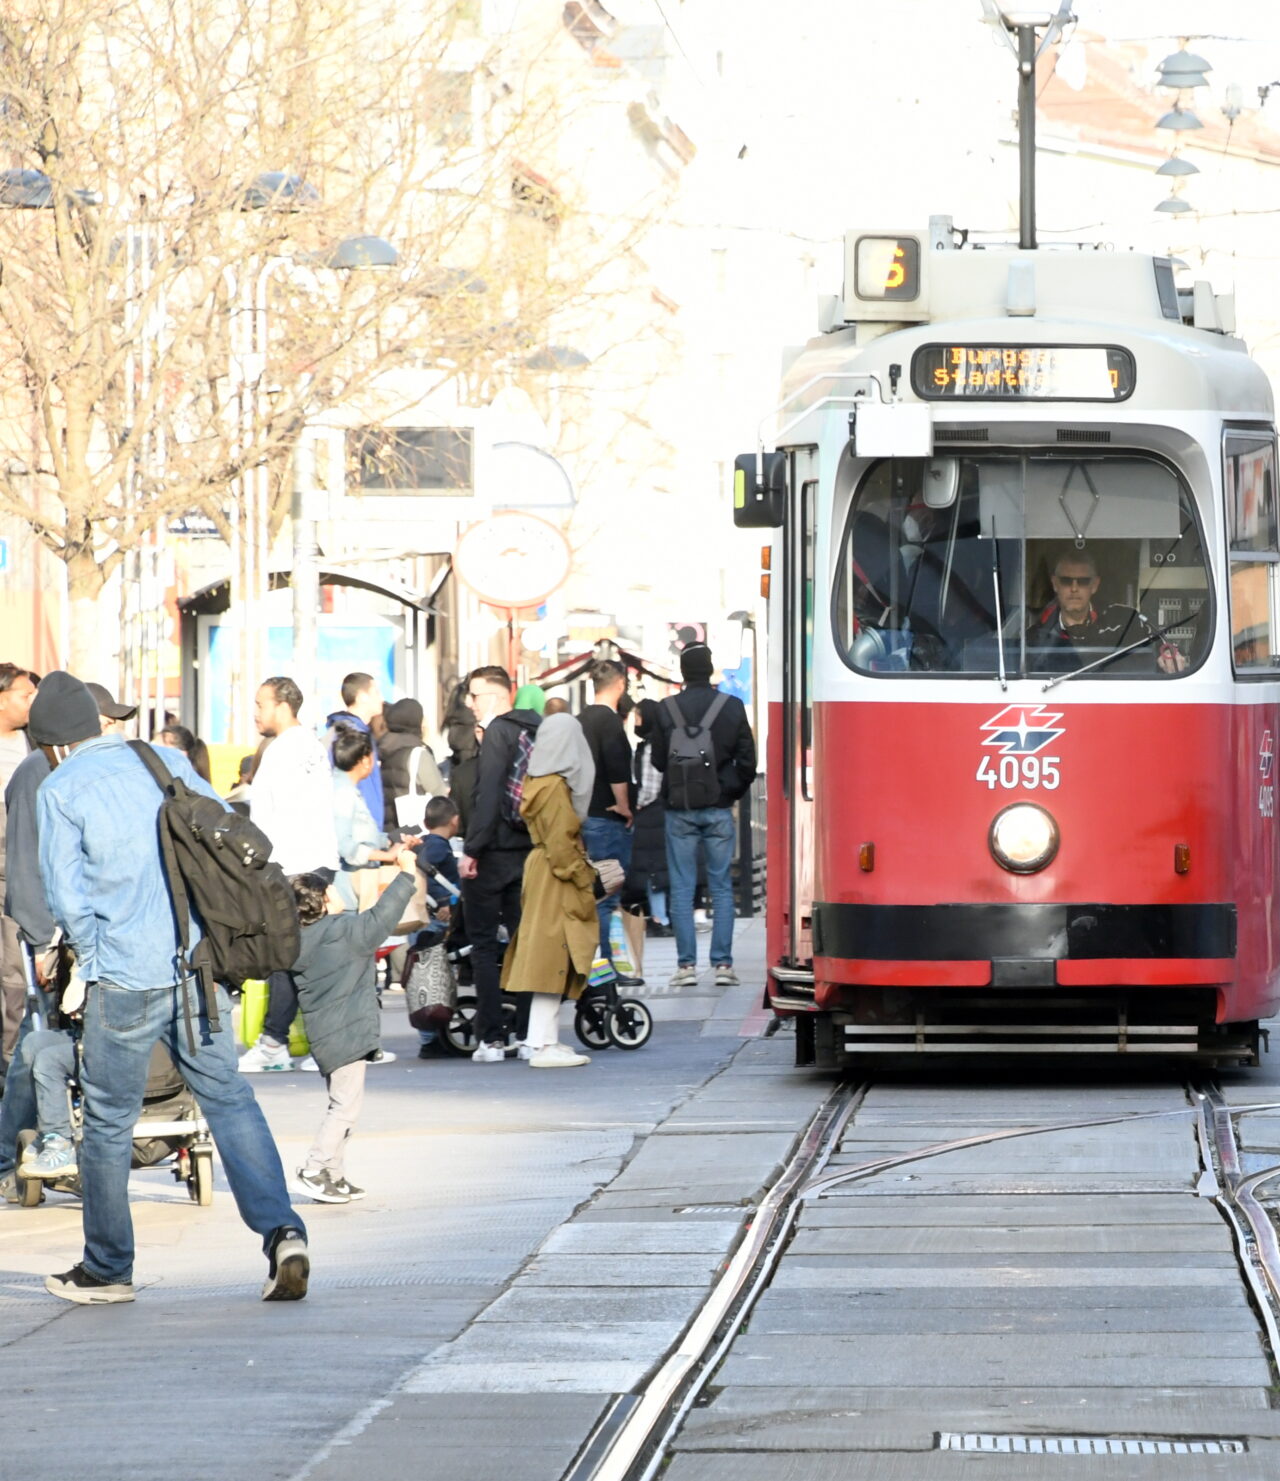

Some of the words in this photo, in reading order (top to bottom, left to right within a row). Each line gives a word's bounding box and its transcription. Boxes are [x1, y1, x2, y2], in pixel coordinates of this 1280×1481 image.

[951, 346, 1062, 366] Burgga
[933, 368, 1058, 386] Stadtha
[975, 755, 1061, 790] 4095
[1259, 785, 1274, 818] 4095
